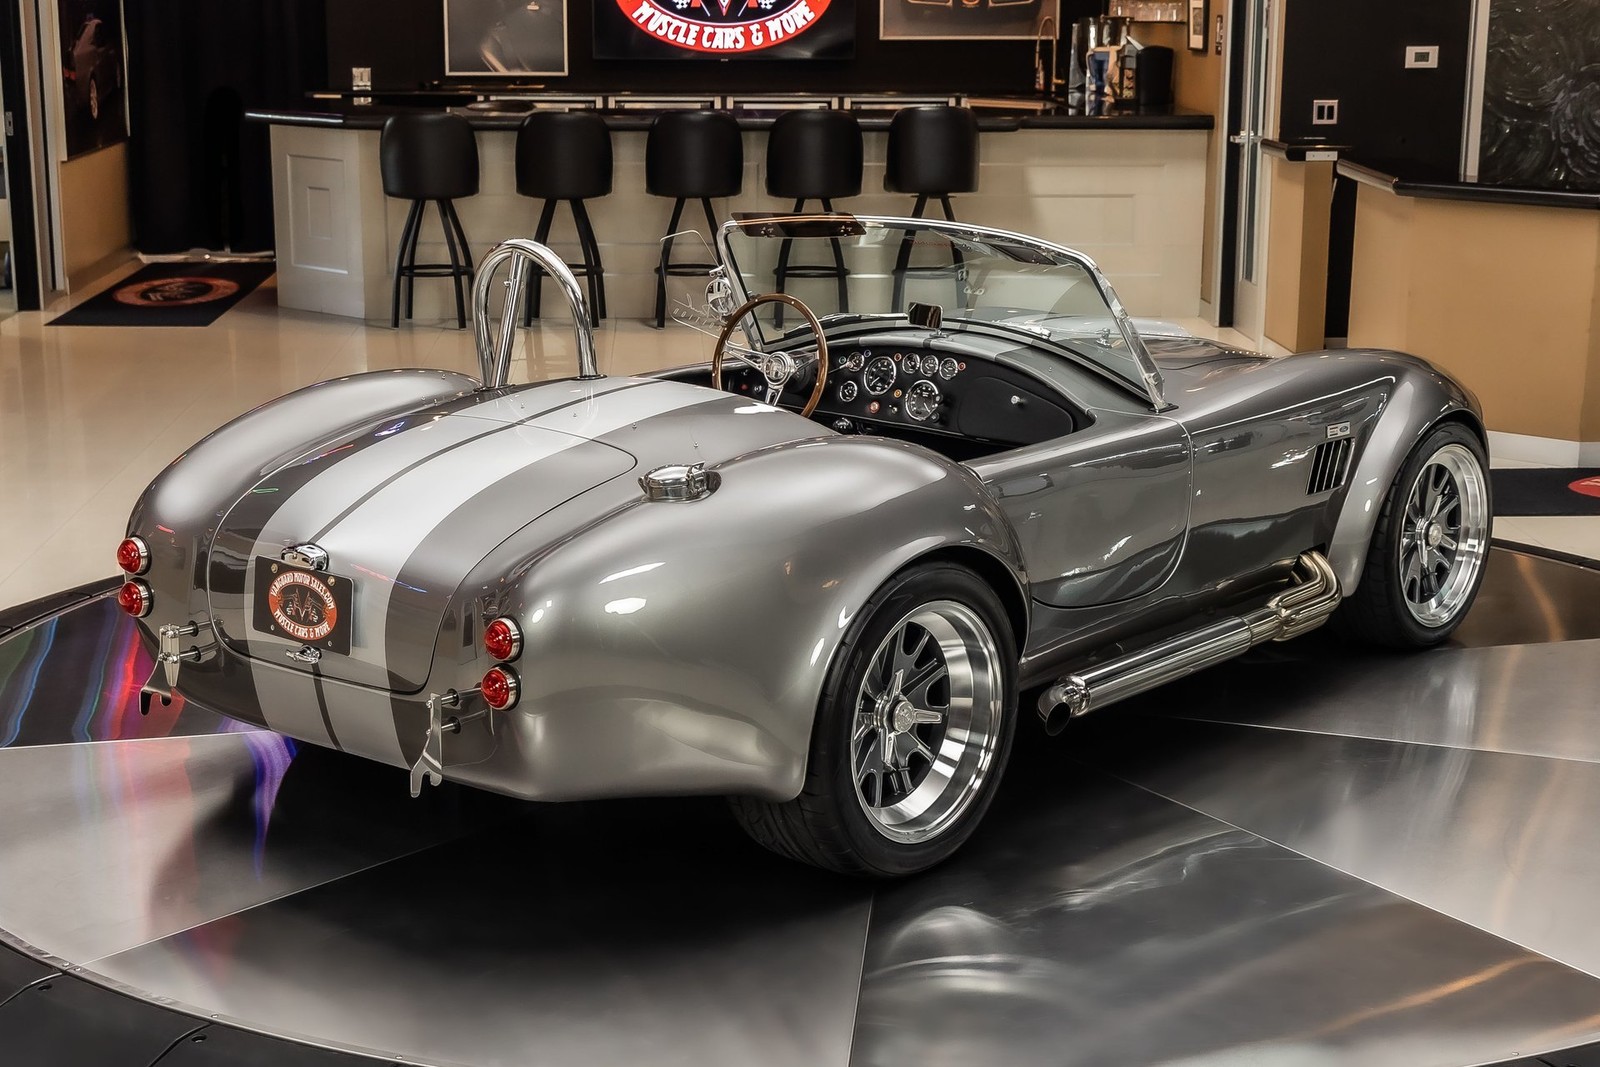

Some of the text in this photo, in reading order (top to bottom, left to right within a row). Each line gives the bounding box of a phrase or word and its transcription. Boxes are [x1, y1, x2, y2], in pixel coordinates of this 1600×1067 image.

[631, 0, 815, 49] MUSCLE CARS & MORE
[274, 608, 331, 638] MUSCLE CARS & MORE
